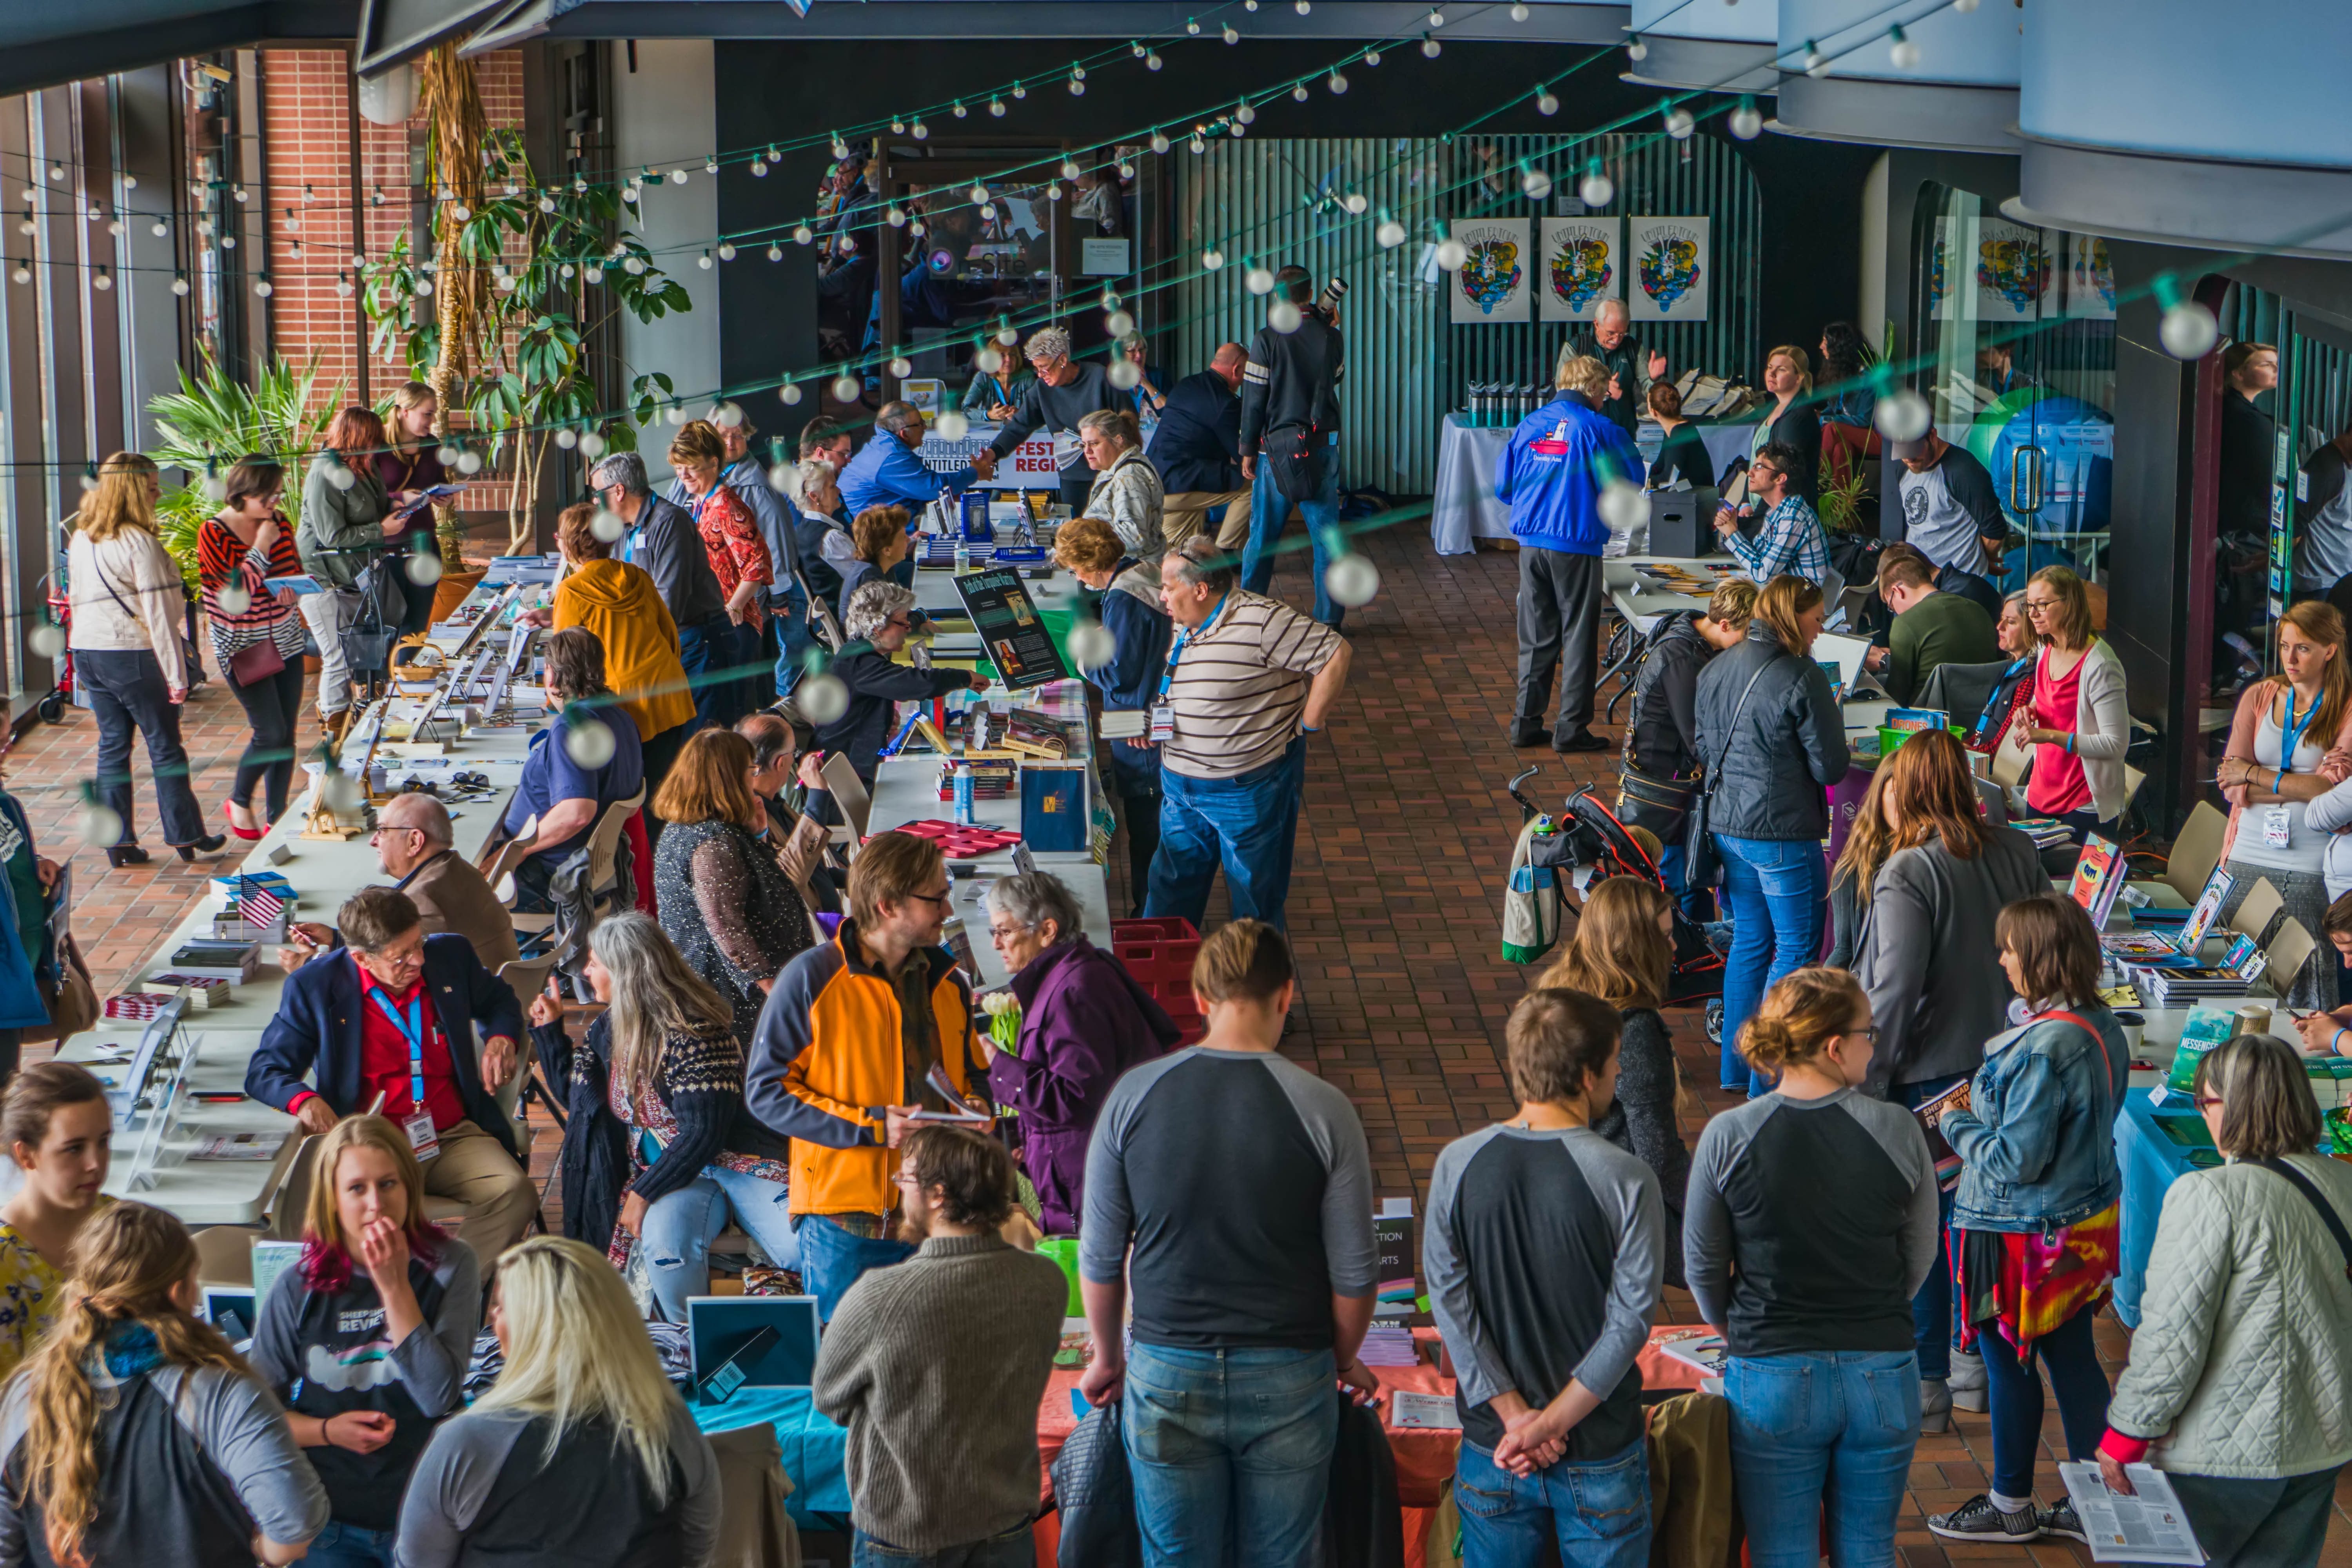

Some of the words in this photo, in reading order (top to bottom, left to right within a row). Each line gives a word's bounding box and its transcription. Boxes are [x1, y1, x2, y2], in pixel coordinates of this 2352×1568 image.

[1016, 442, 1054, 456] FEST
[1016, 458, 1059, 472] REGI
[1891, 718, 1927, 732] DRONES
[1005, 741, 1031, 751] ROSEBLOOM
[2084, 864, 2097, 879] GUTS
[1374, 1232, 1402, 1242] TION
